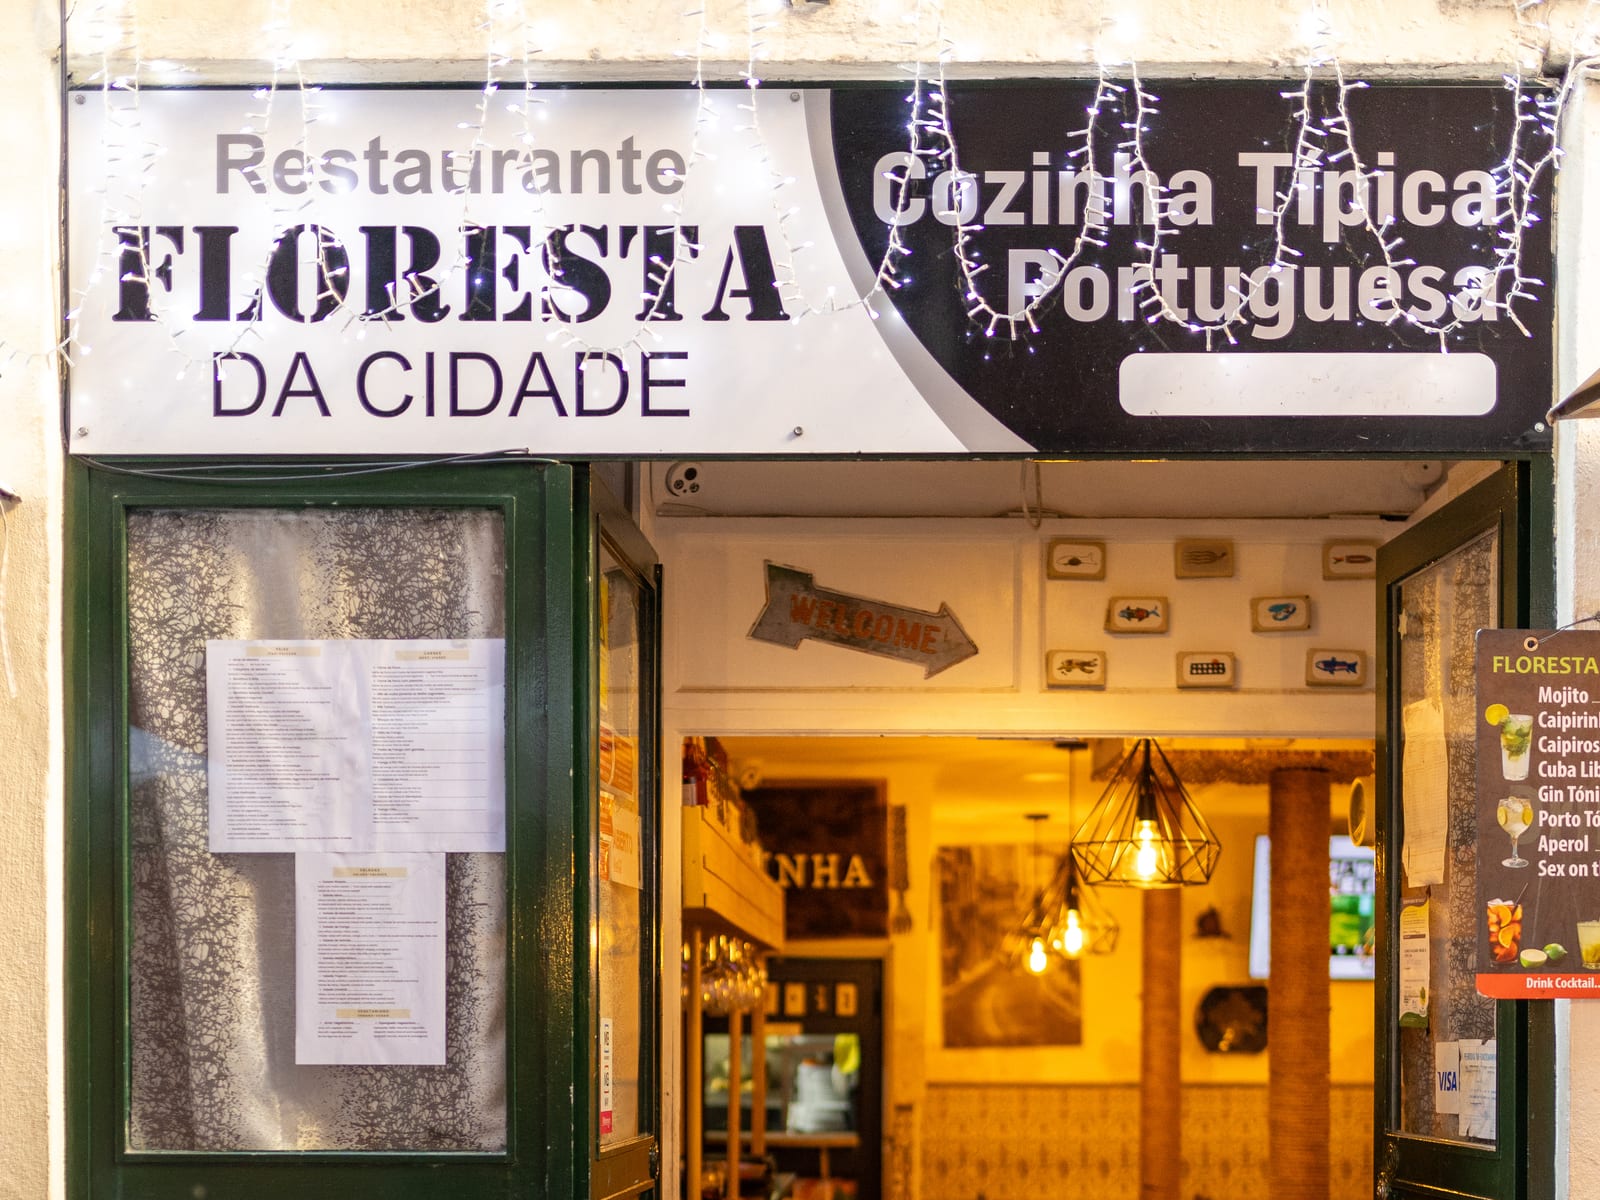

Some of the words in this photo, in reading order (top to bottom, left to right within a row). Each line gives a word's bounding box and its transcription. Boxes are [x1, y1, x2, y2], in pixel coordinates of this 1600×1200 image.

[215, 133, 687, 196] Restaurante
[873, 151, 1213, 227] Cozinha
[1238, 151, 1498, 243] Típica
[111, 224, 791, 323] FLORESTA
[1007, 248, 1498, 340] Portuguesa
[212, 351, 333, 418] DA
[356, 350, 692, 419] CIDADE
[790, 594, 942, 655] WELCOME
[1492, 655, 1600, 675] FLORESTA
[1538, 686, 1589, 708] Mojito
[1537, 711, 1600, 733] Caipirin
[1537, 760, 1577, 778] Cuba
[1537, 785, 1564, 803] Gin
[1538, 810, 1581, 827] Porto
[1537, 834, 1589, 856] Aperol
[764, 853, 874, 888] NHA
[1537, 859, 1565, 877] Sex
[1568, 863, 1589, 877] on
[1592, 861, 1600, 877] t
[1526, 977, 1554, 989] Drink
[1437, 1071, 1457, 1092] VISA
